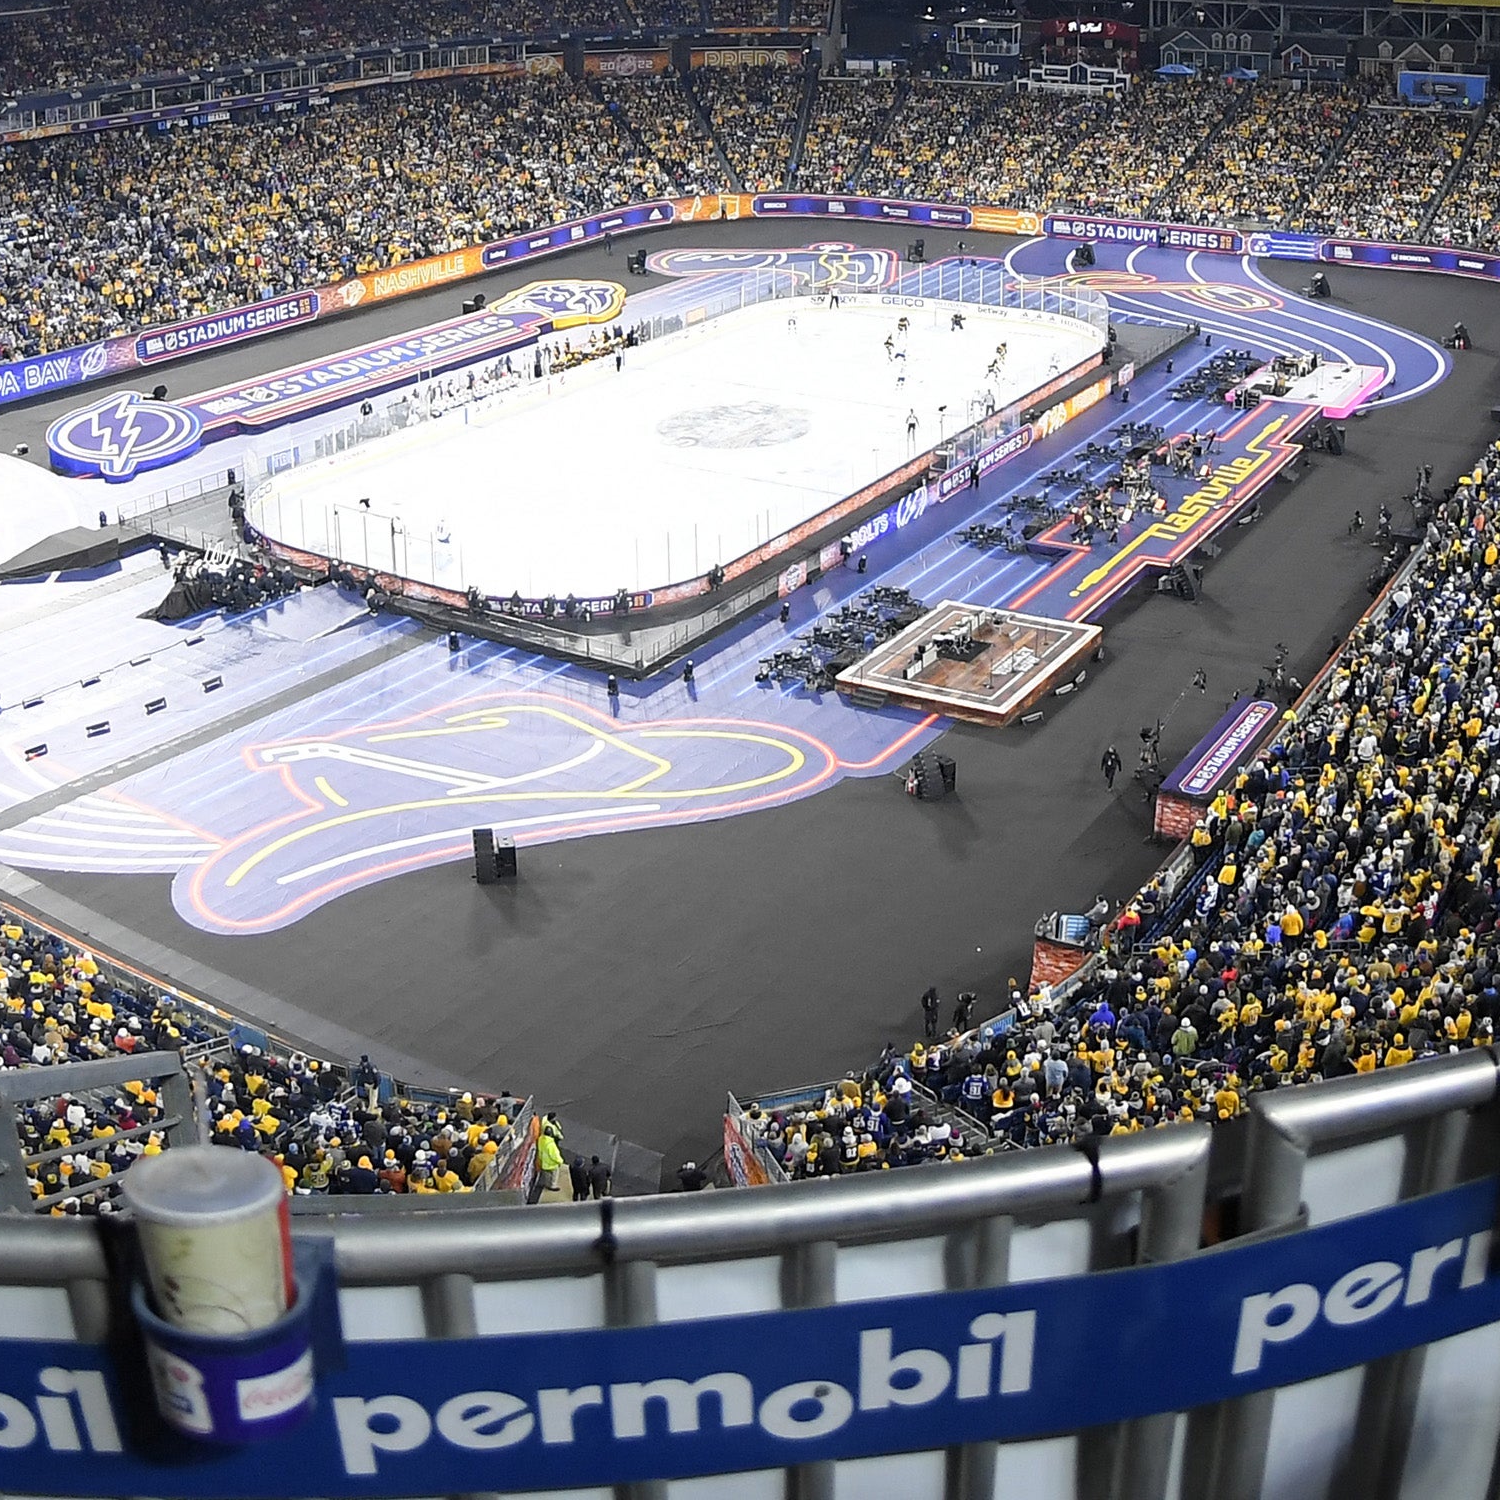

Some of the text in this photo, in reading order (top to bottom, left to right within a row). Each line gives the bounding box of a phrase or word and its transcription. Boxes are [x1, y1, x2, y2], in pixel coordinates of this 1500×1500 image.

[705, 50, 788, 68] PREDS
[1084, 220, 1157, 242] STADIUM
[1399, 255, 1431, 263] HONDA
[375, 255, 465, 295] NASHVILLE
[881, 297, 924, 308] GEICO
[978, 306, 1008, 318] betway
[178, 316, 246, 349] STADIUM
[246, 301, 299, 329] SERIES
[274, 312, 516, 396] STADIUM SERIES
[25, 357, 71, 388] BAY
[993, 435, 1023, 462] SERIES
[1204, 710, 1265, 779] STADIUM SERIES
[332, 1308, 1037, 1477] permobil
